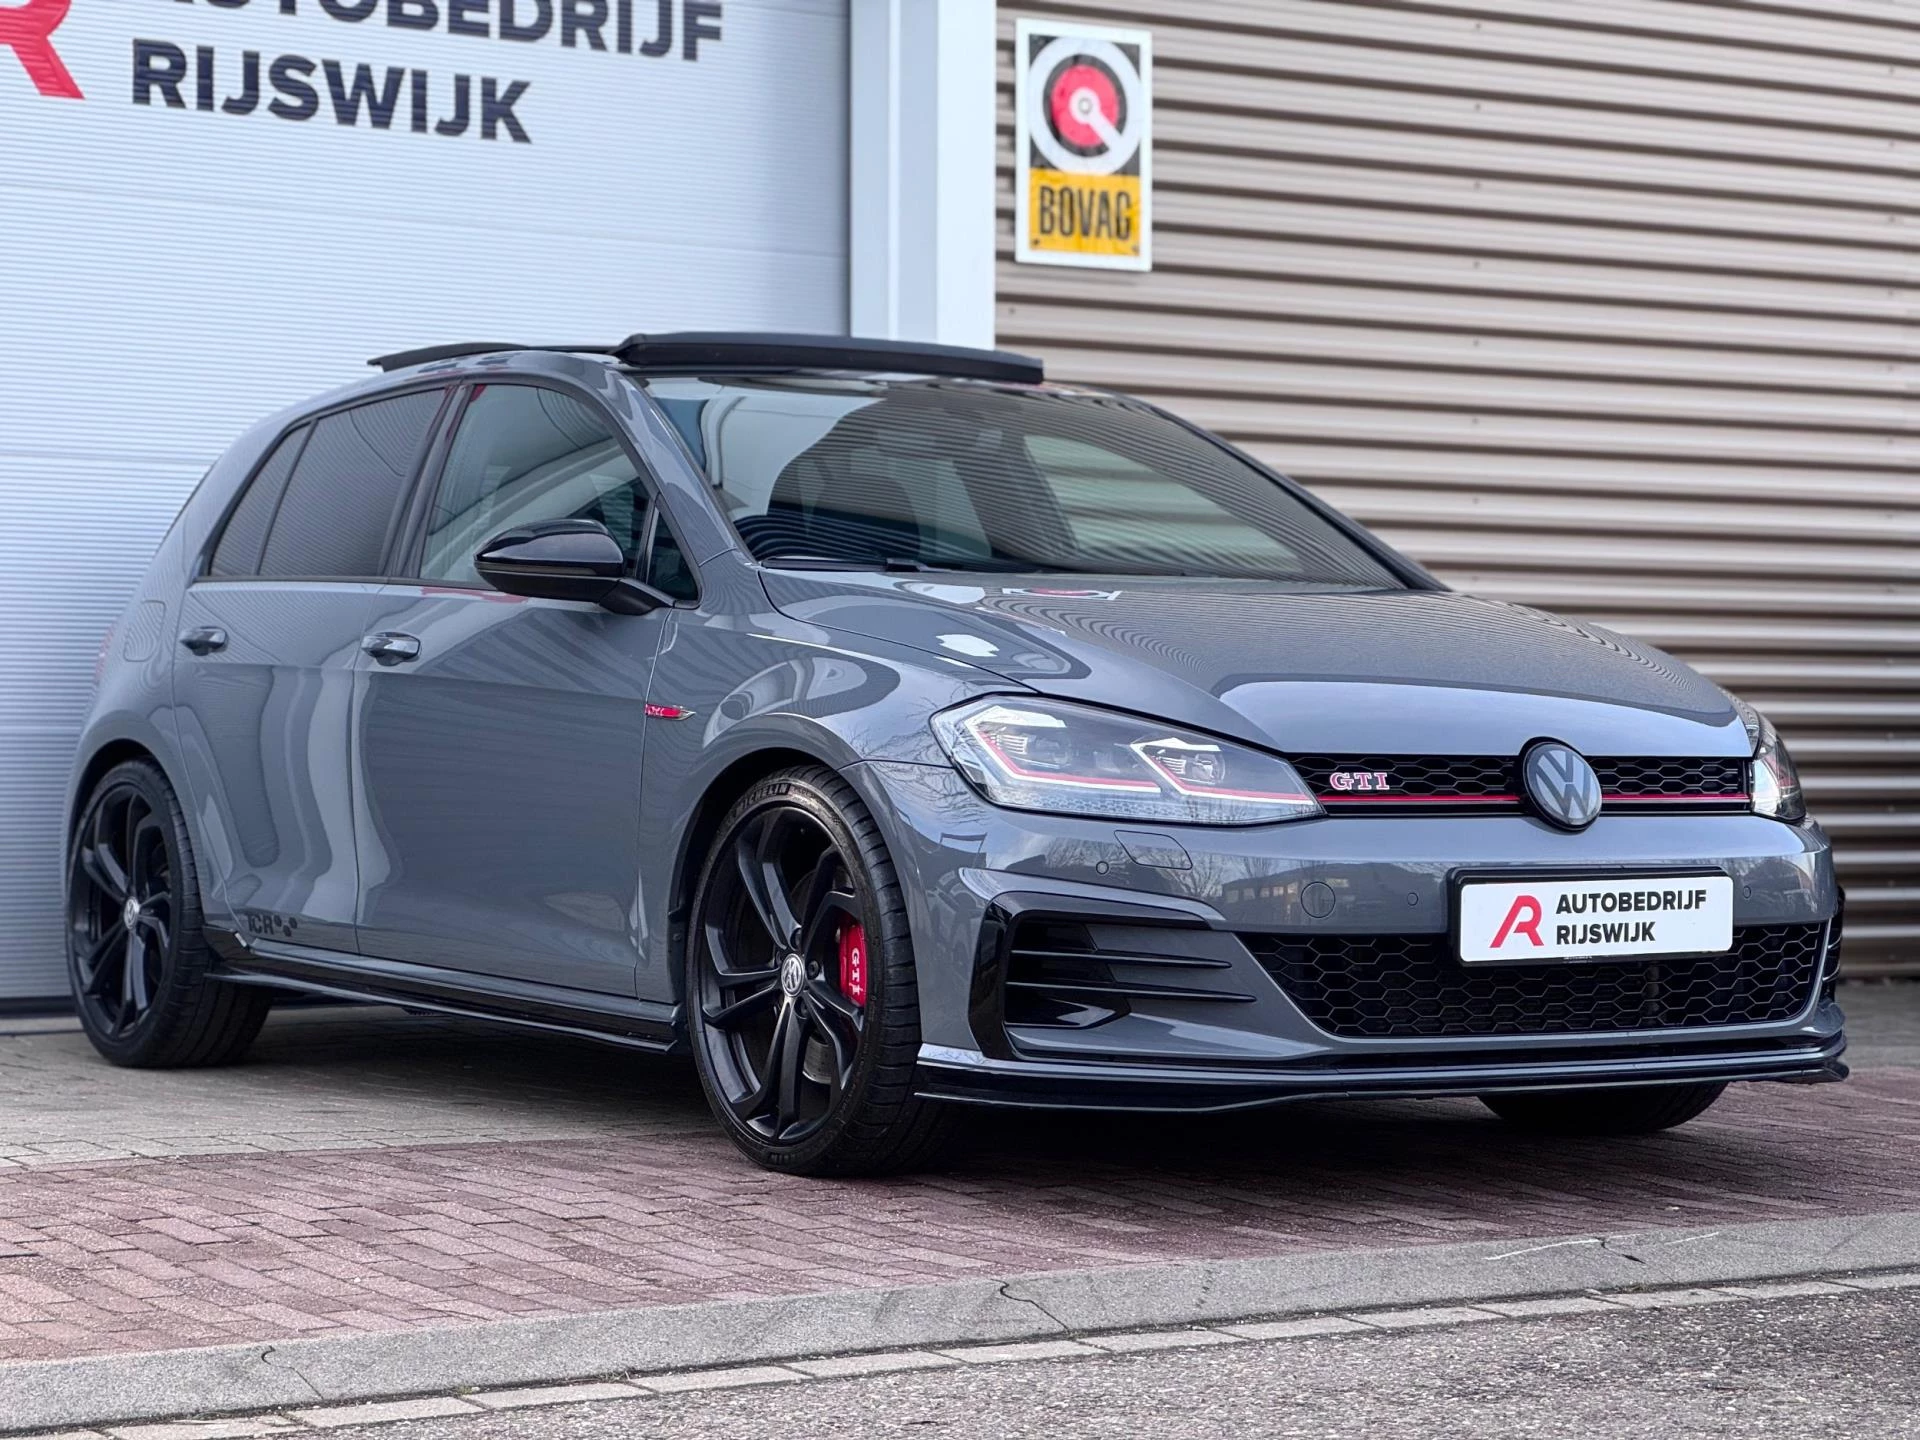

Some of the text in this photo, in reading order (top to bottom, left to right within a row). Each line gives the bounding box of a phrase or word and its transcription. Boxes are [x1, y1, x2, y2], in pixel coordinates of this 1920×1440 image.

[182, 0, 721, 61] EDRIJF
[132, 38, 532, 144] RIJSWIJK
[1040, 186, 1130, 240] BOVAG
[1329, 772, 1390, 790] GTI
[1556, 890, 1707, 914] AUTOBEDRIJF
[1556, 922, 1656, 945] RIJSWIJK
